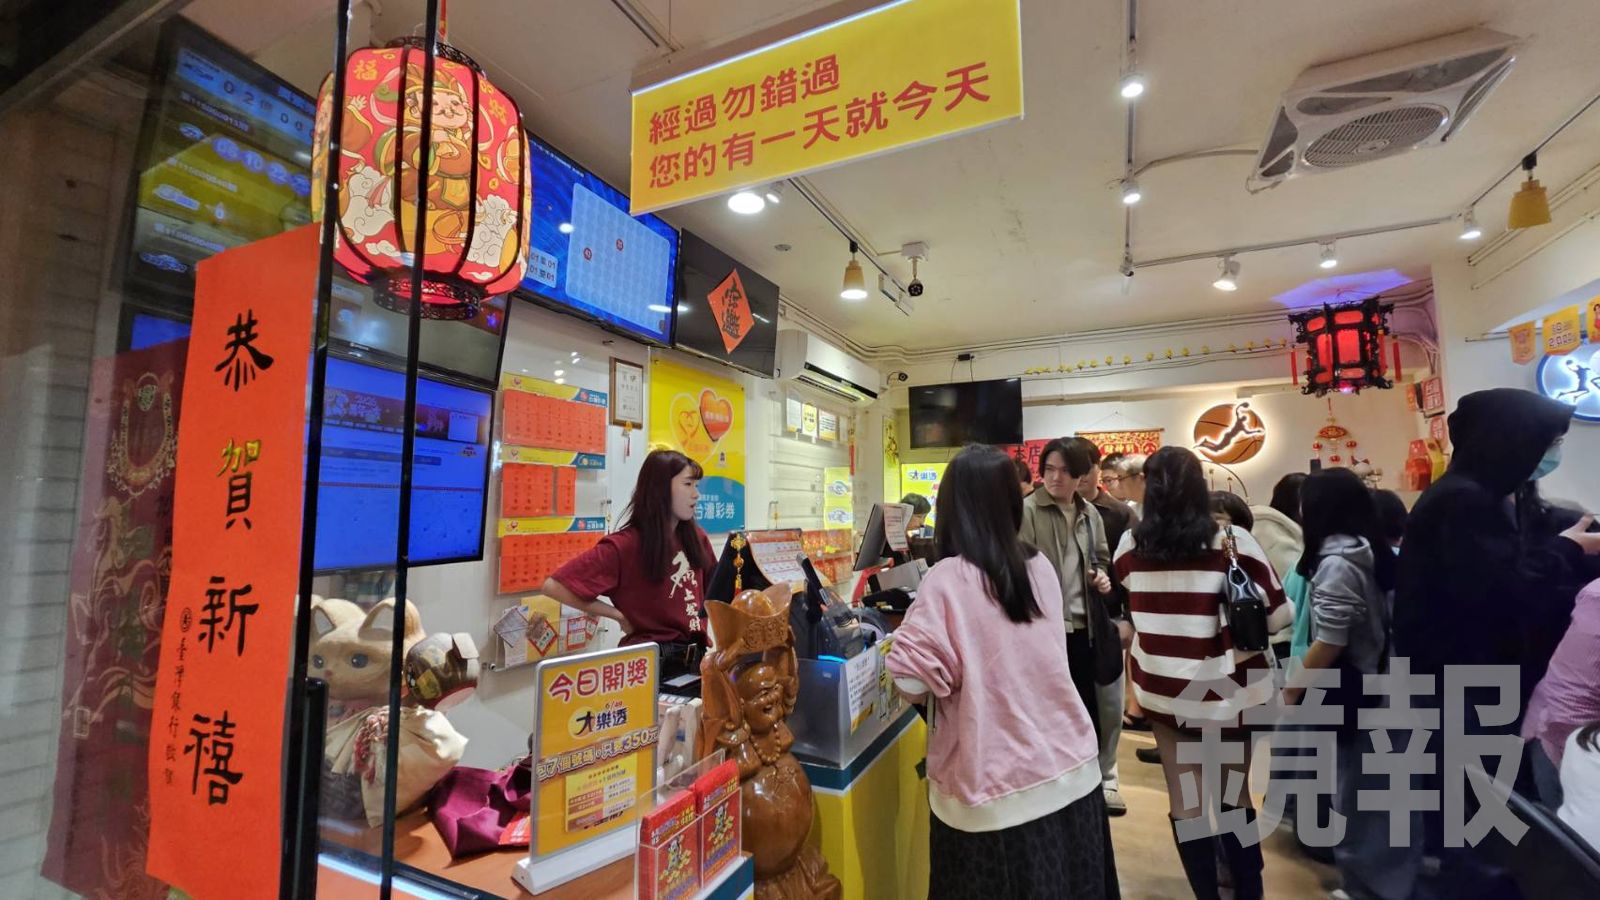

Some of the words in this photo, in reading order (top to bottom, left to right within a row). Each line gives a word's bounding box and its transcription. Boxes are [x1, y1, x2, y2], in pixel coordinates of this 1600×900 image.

[648, 53, 841, 146] 經過勿錯過
[648, 60, 991, 190] 您的有一天就今天
[695, 502, 735, 520] 台灣彩券
[183, 308, 275, 807] 恭賀新禧
[548, 657, 649, 703] 今日開獎
[574, 707, 629, 736] 大樂透
